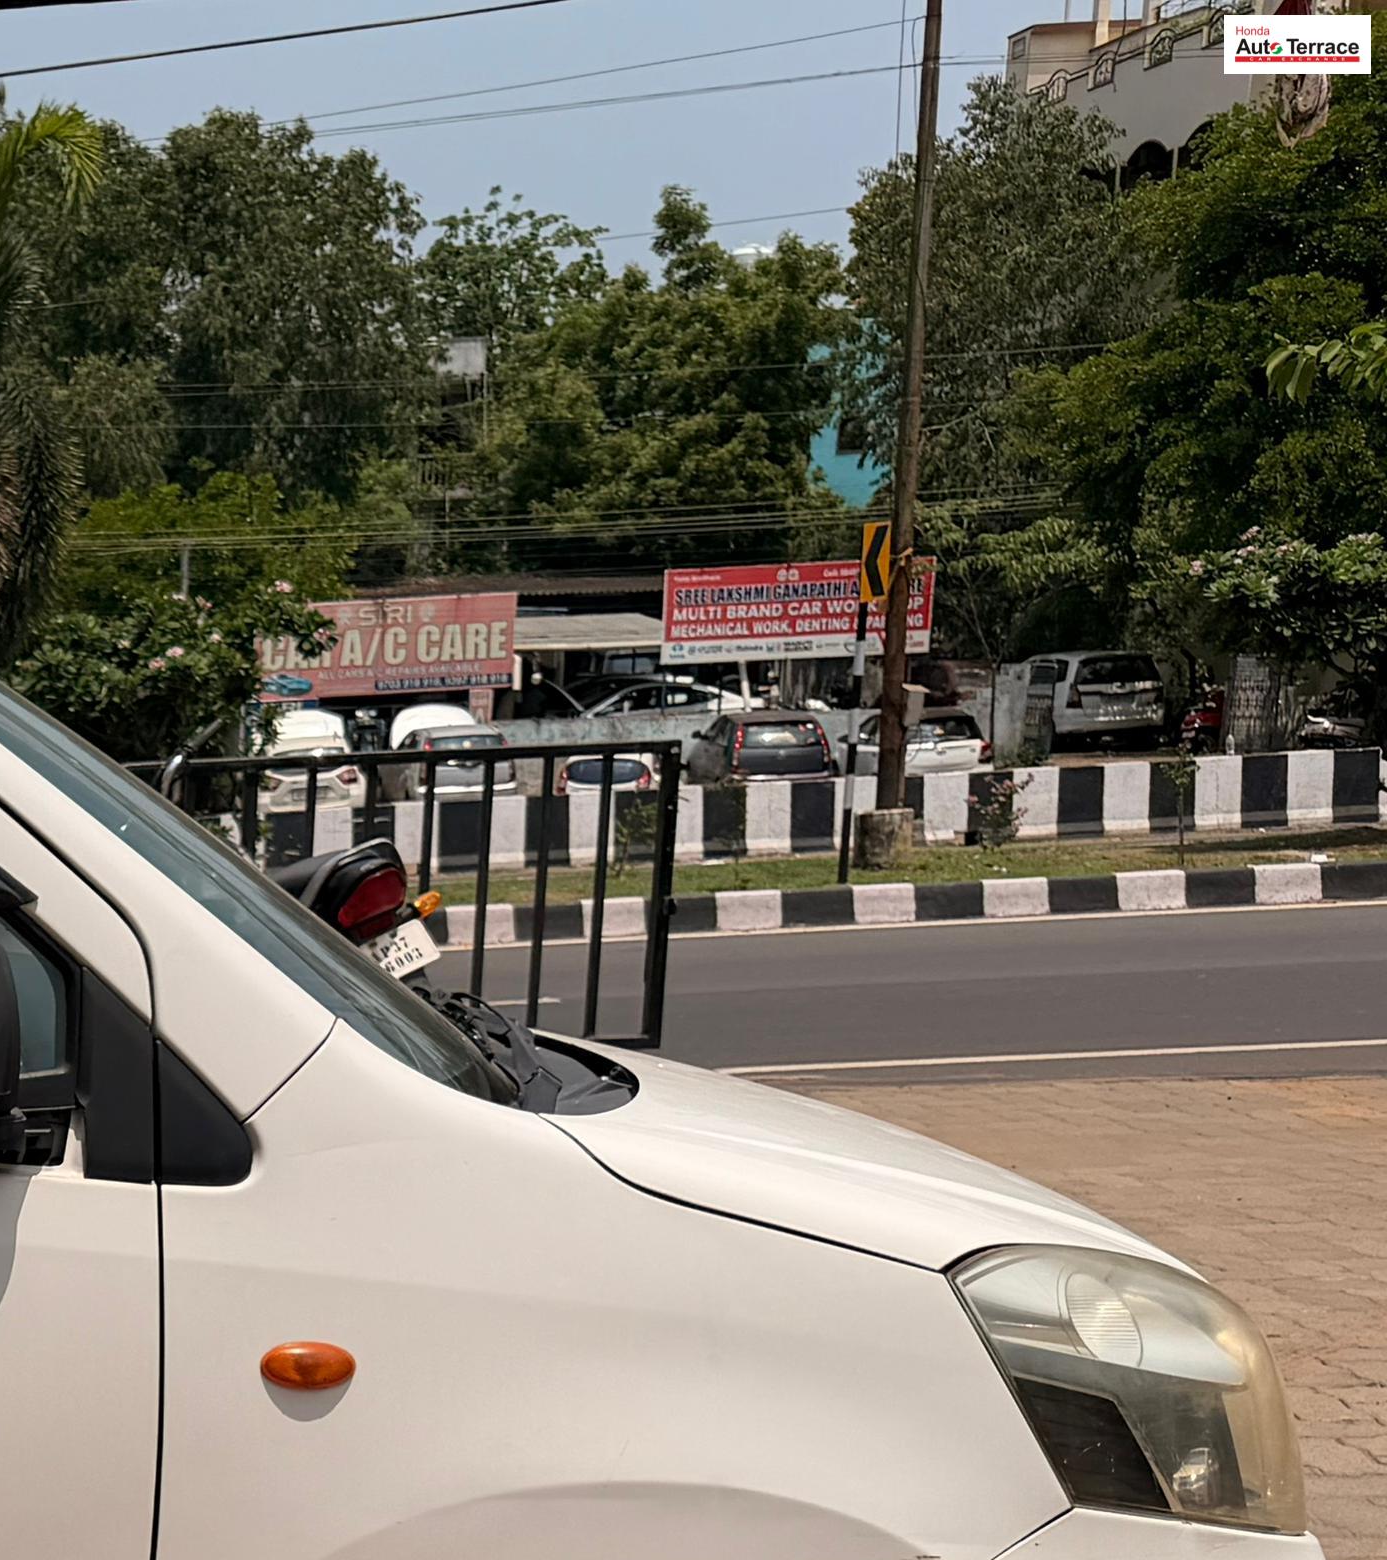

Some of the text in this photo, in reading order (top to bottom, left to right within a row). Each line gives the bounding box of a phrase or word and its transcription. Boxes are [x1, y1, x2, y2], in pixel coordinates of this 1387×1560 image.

[675, 587, 708, 607] SREE
[710, 585, 770, 604] LAKSHMI
[358, 604, 412, 627] SIRI
[673, 599, 878, 621] MULTI BRAND CAR WOK
[670, 621, 749, 638] MECHANICAL
[752, 619, 793, 634] WORK,
[795, 616, 850, 632] DENTING
[339, 626, 408, 667] A/C
[416, 620, 509, 664] CARE
